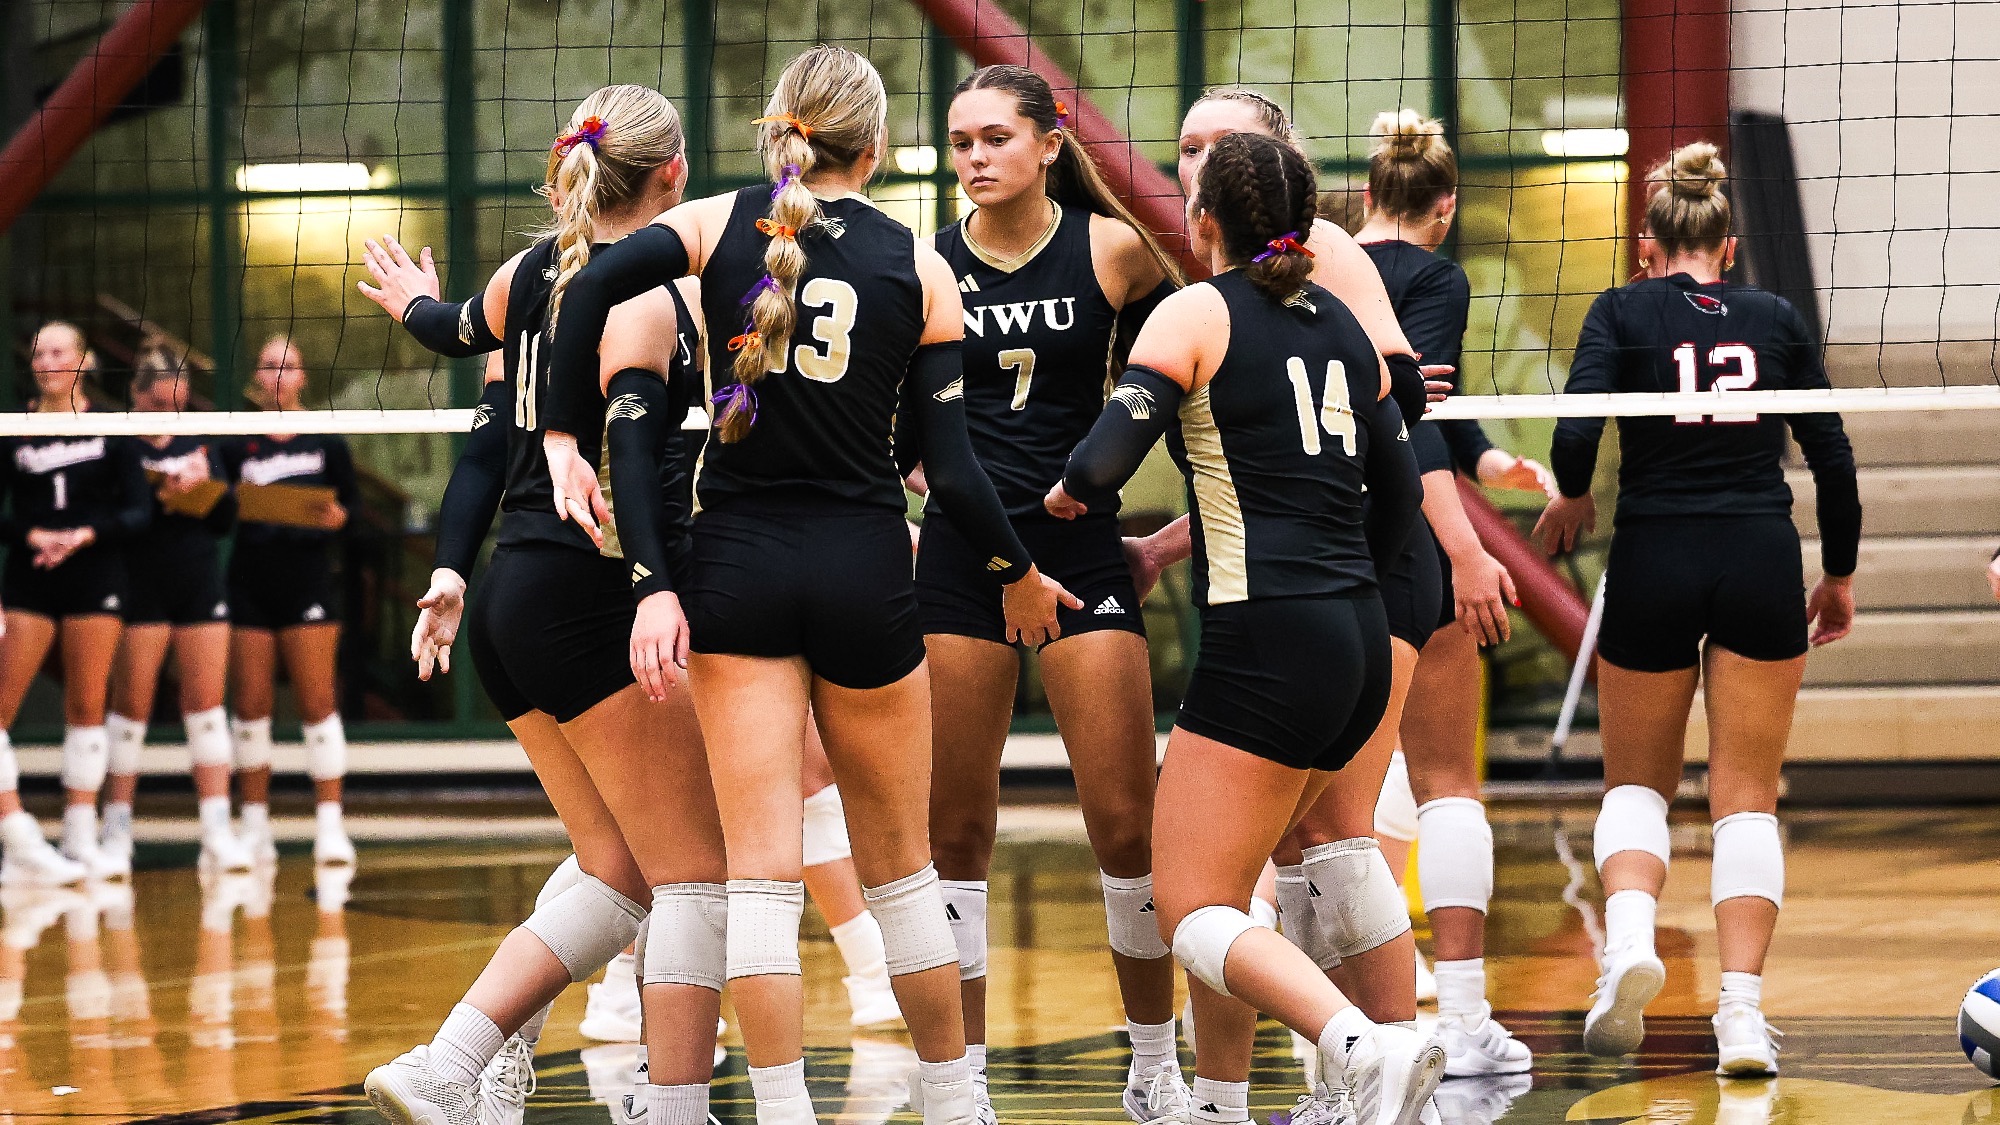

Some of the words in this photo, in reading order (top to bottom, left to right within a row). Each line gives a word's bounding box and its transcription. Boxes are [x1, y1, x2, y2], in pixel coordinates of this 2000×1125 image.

[963, 297, 1076, 338] NWU
[998, 347, 1036, 411] 7
[1286, 356, 1357, 456] 14
[1672, 342, 1760, 425] 12
[1093, 606, 1126, 615] adidas
